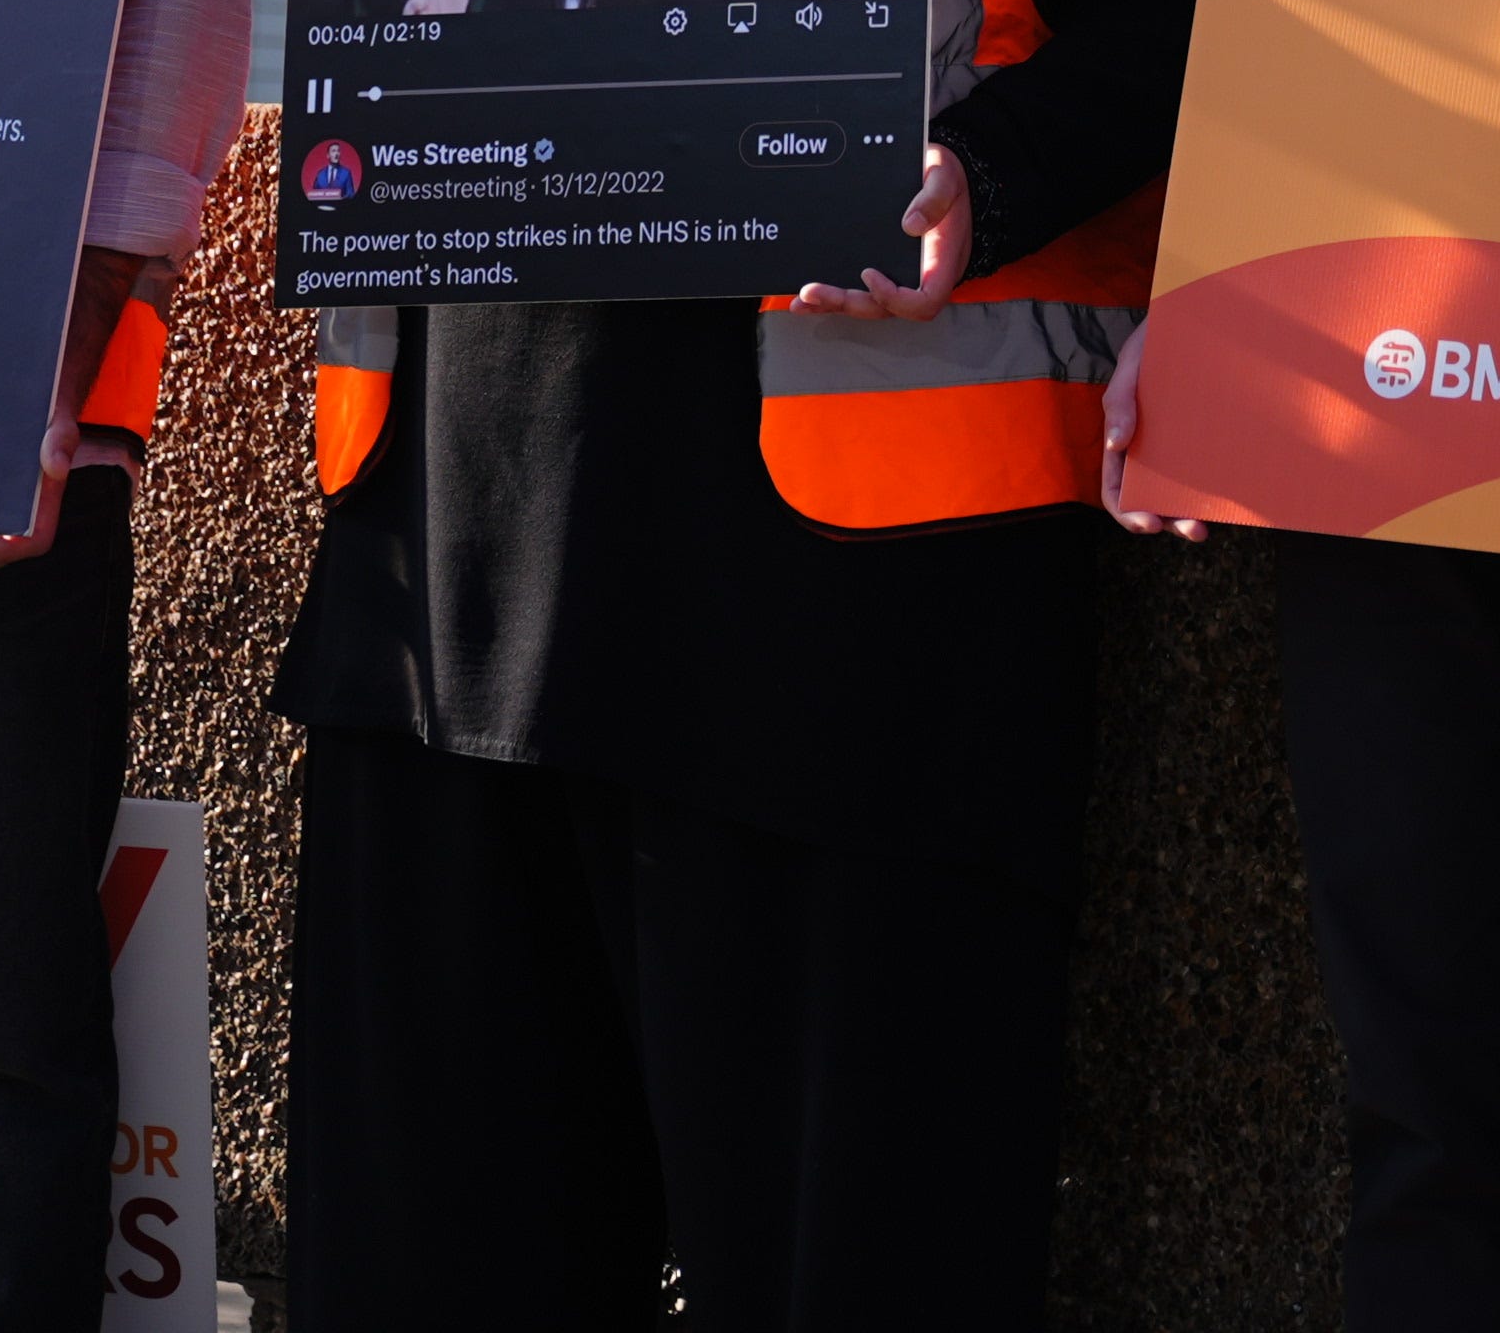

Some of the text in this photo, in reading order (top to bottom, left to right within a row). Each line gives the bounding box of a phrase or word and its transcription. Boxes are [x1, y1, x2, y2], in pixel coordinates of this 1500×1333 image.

[308, 24, 366, 46] 00:04
[383, 21, 441, 43] 02:19
[371, 140, 528, 168] Wes Streeting
[758, 133, 828, 155] Follow
[370, 170, 665, 203] @wesstreeting 13/12/2022
[298, 217, 779, 257] The power to stop strikes in the NHS is in the
[446, 261, 518, 285] hands.
[111, 1124, 179, 1179] OR
